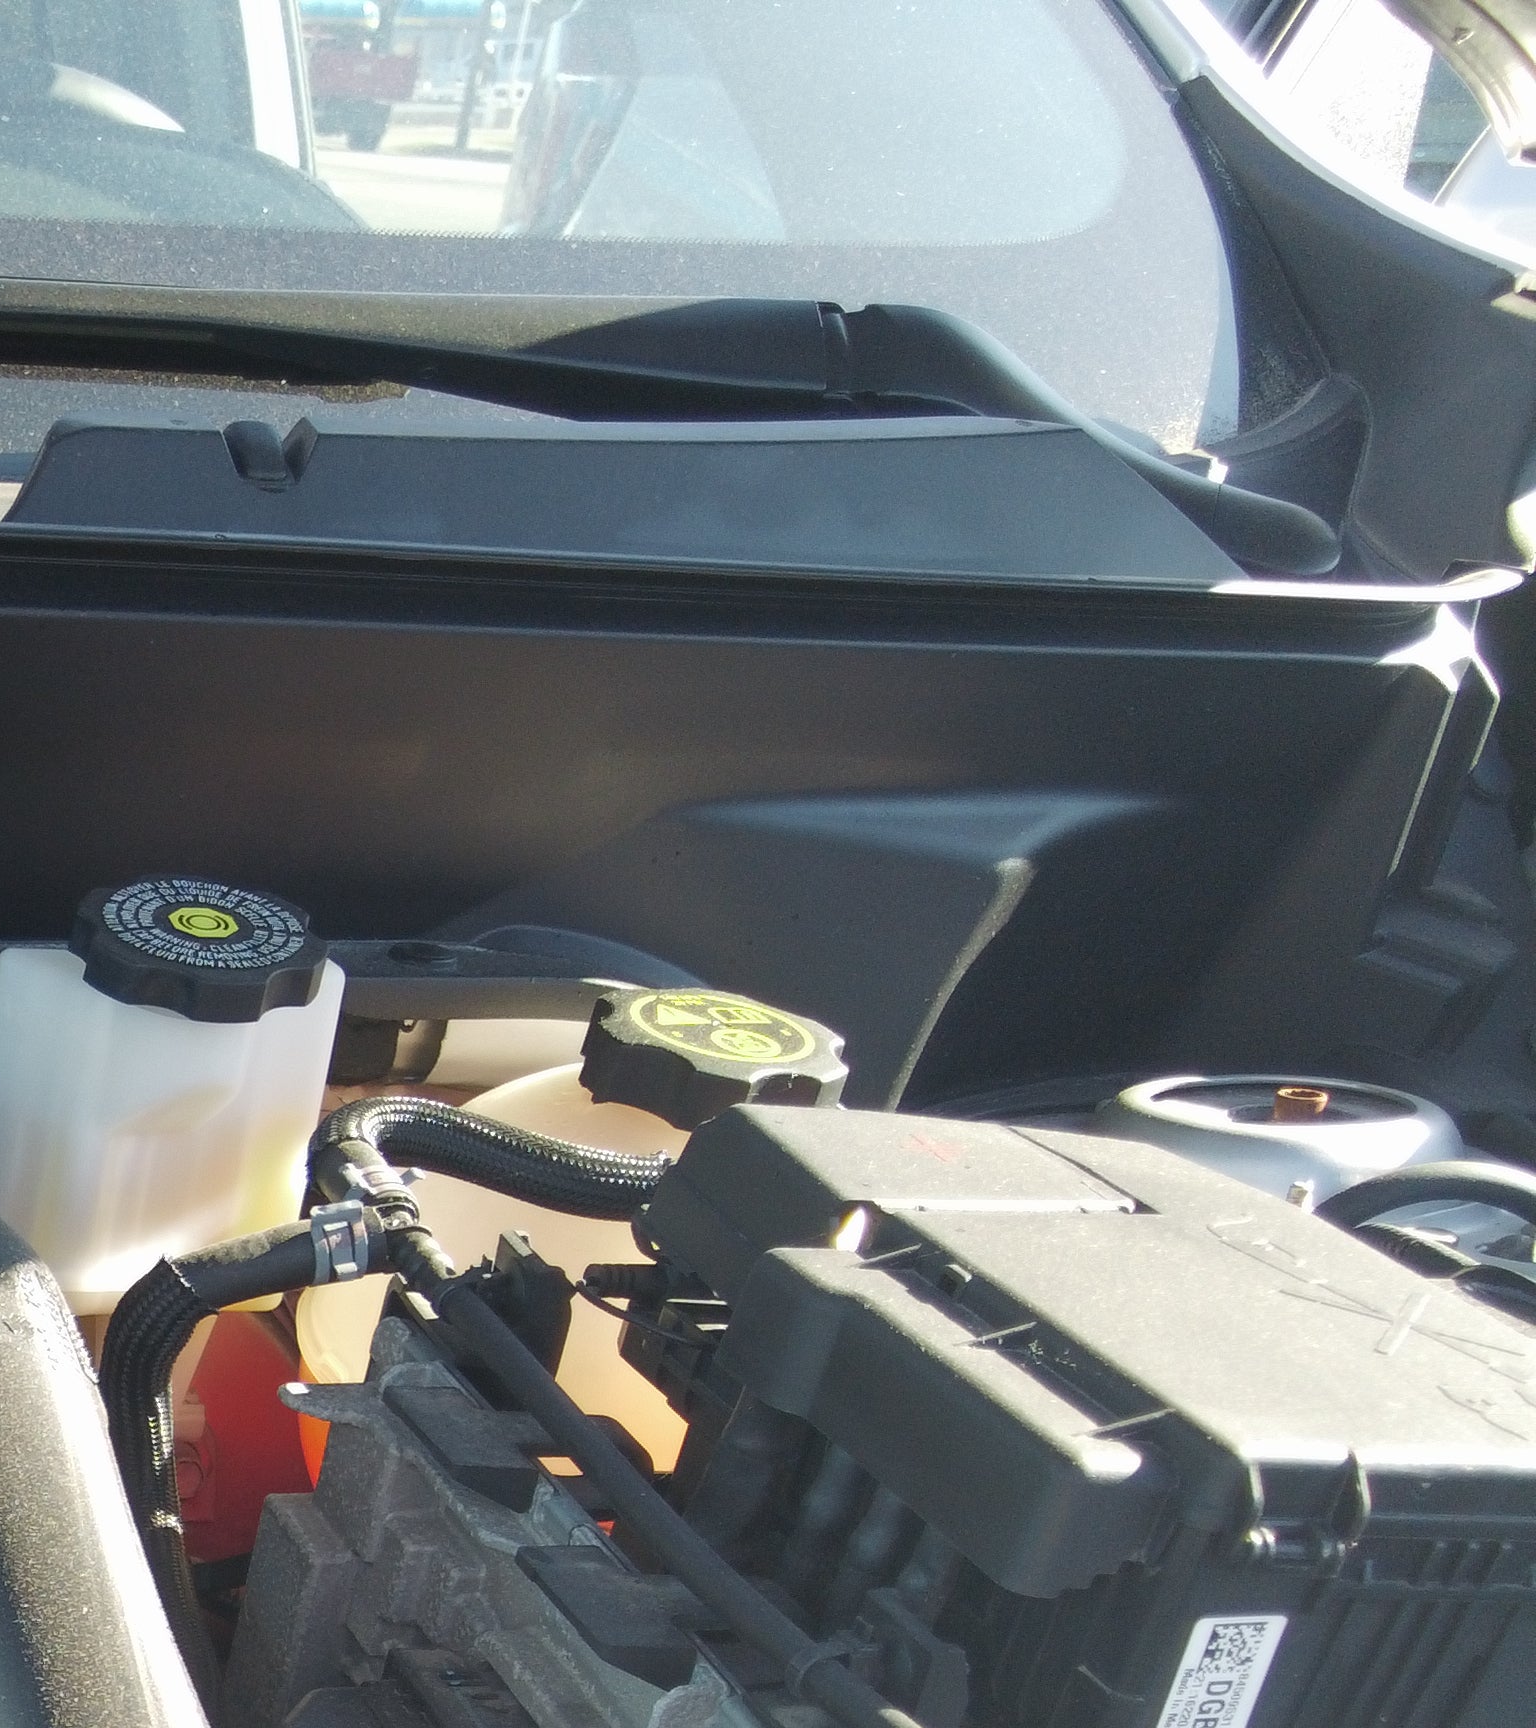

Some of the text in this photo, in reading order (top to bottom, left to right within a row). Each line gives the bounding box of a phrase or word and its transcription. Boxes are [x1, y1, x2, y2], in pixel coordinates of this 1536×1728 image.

[156, 880, 170, 888] LE
[173, 880, 227, 892] BOUCHON
[231, 889, 267, 903] AVANT
[265, 903, 281, 912] LA
[158, 888, 175, 896] DU
[227, 893, 243, 904] DE
[198, 895, 237, 909] BIDON
[132, 929, 154, 945] CAP
[151, 936, 194, 958] BEFORE
[179, 954, 215, 968] FROM
[217, 960, 227, 969] A
[227, 956, 271, 969] SEALED
